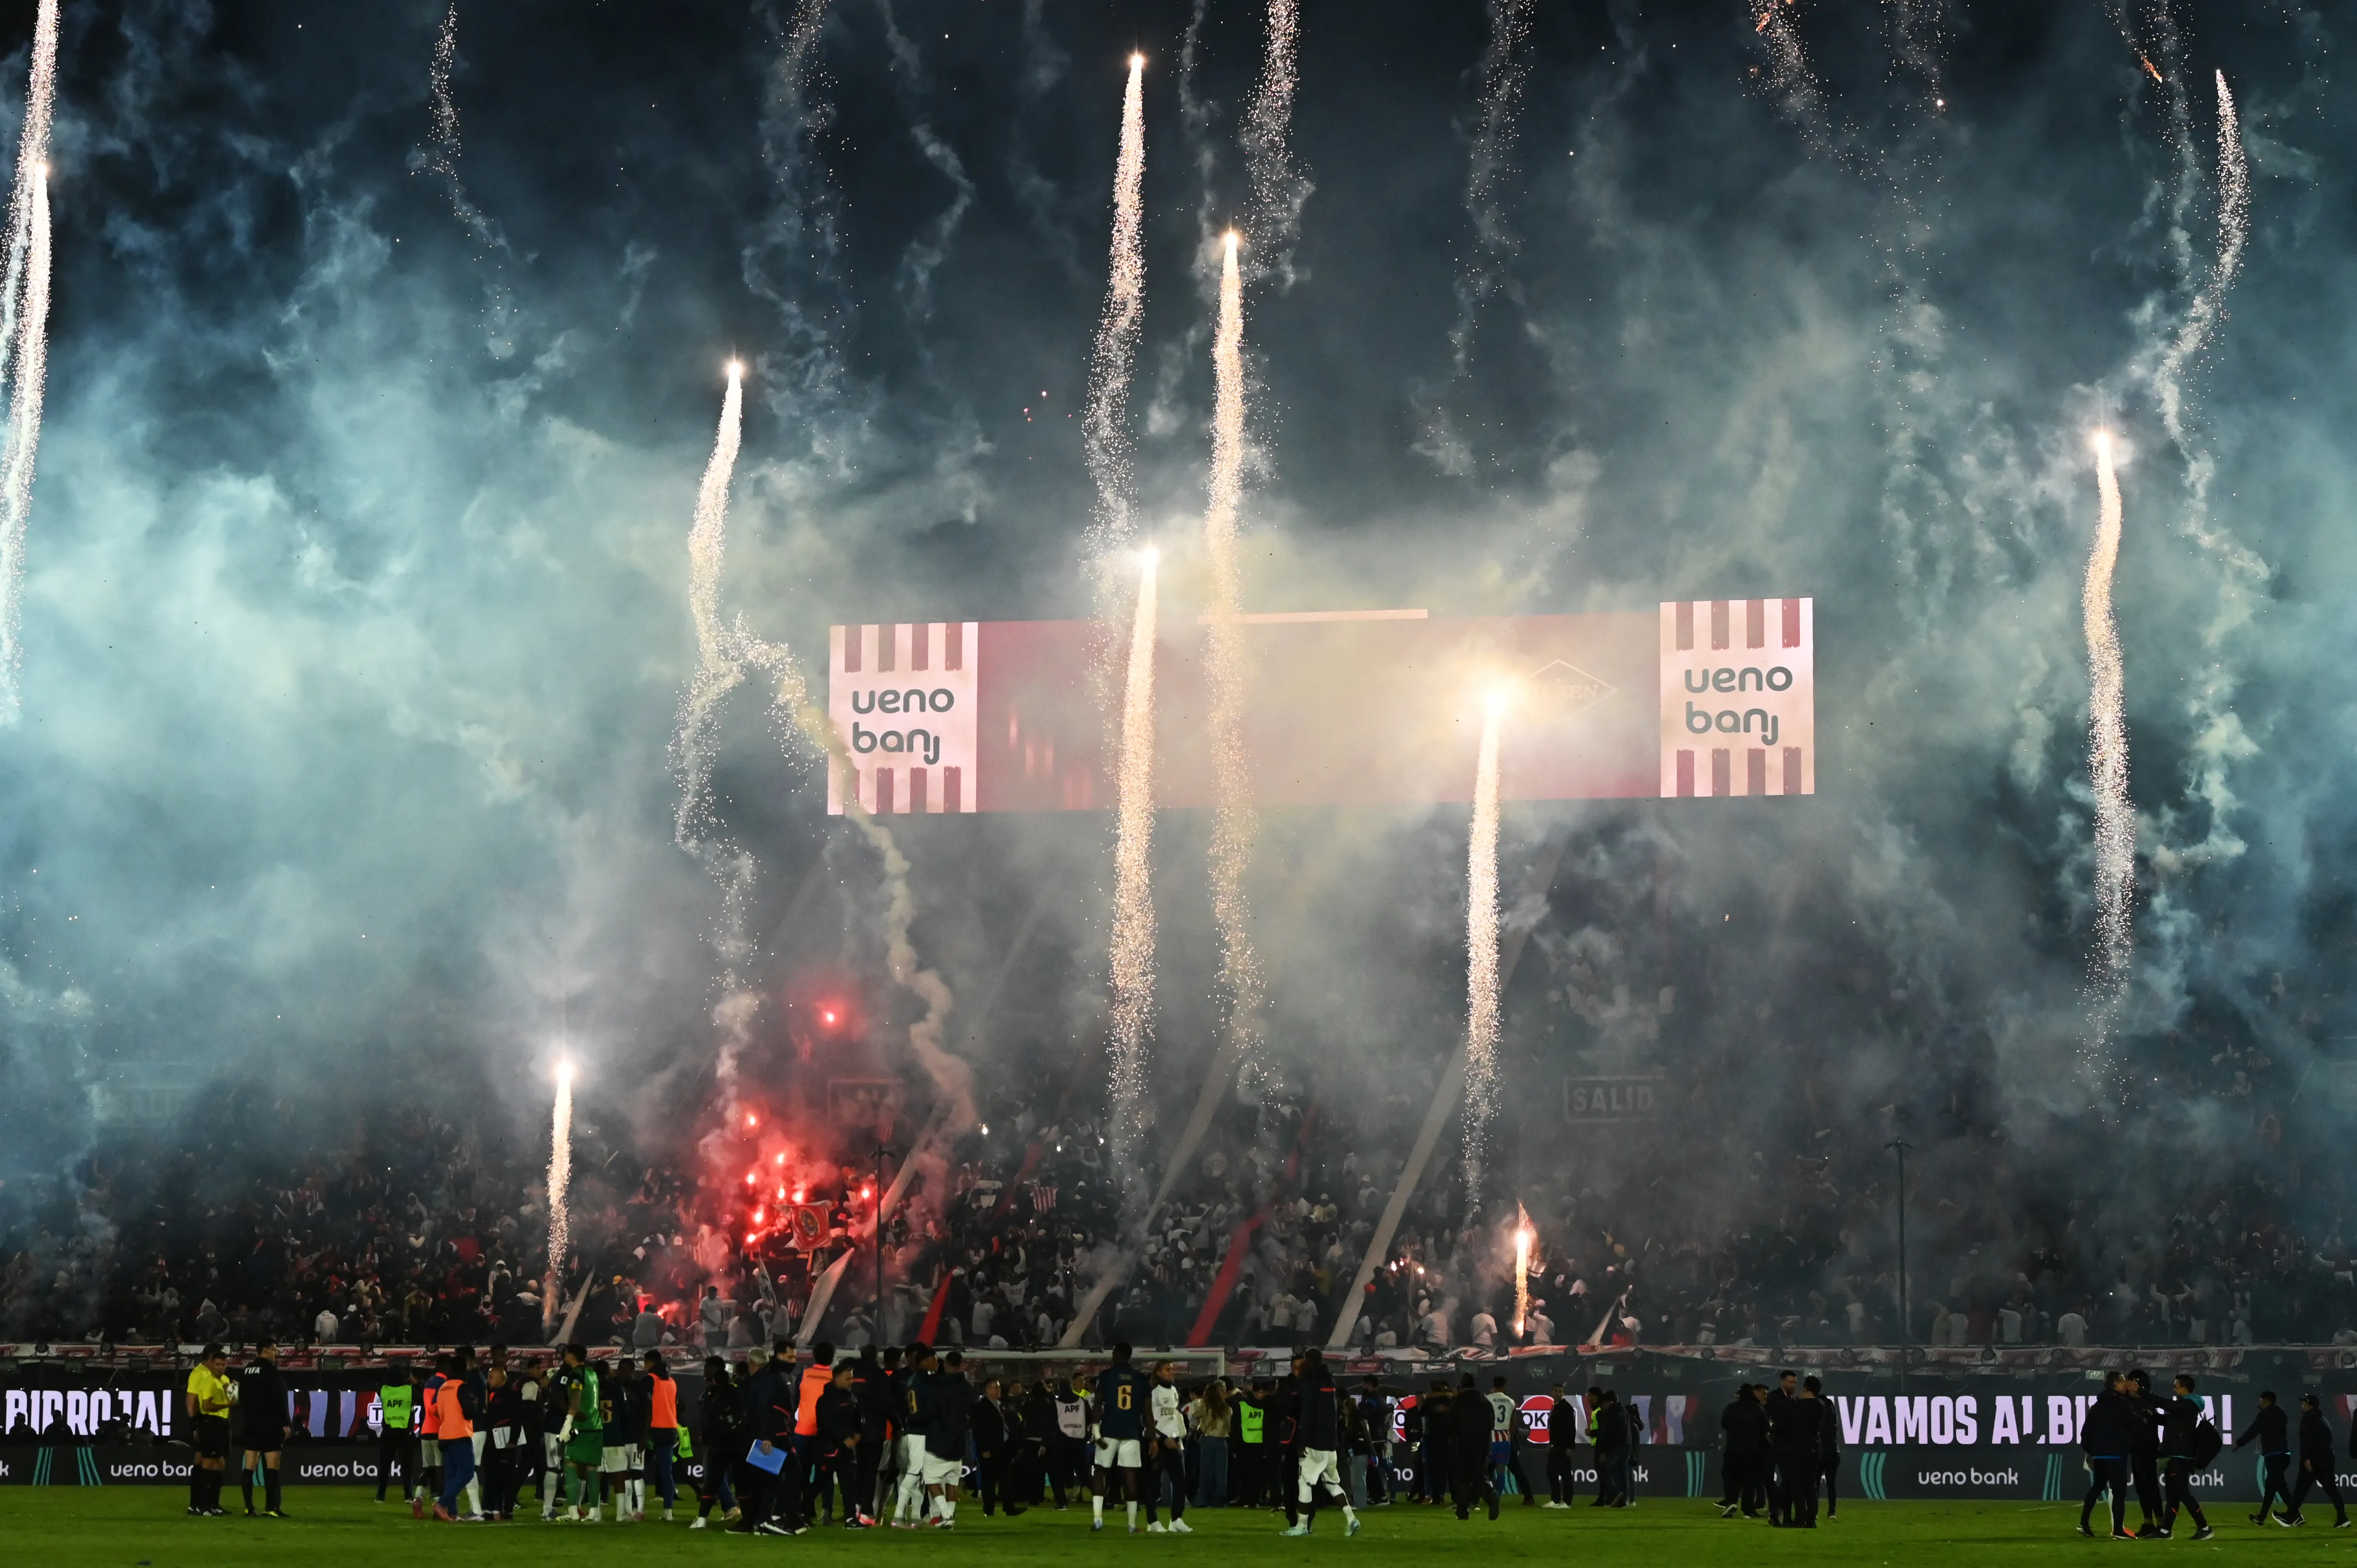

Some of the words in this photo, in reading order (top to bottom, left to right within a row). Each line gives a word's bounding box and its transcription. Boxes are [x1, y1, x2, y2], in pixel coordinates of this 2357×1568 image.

[1685, 666, 1793, 693] ueno
[852, 688, 954, 714] ueno
[1572, 1086, 1654, 1112] SALID
[244, 1367, 260, 1375] FIFA
[1118, 1385, 1132, 1410] 6
[0, 1390, 172, 1436] BIRROJA!
[1497, 1405, 1506, 1423] 3
[1827, 1396, 1977, 1444] VAMOS
[111, 1464, 158, 1477] ueno
[300, 1464, 349, 1477] ueno
[353, 1460, 401, 1477] bak
[1918, 1471, 1966, 1485] ueno
[1970, 1467, 2019, 1485] bank
[2189, 1469, 2224, 1486] ank
